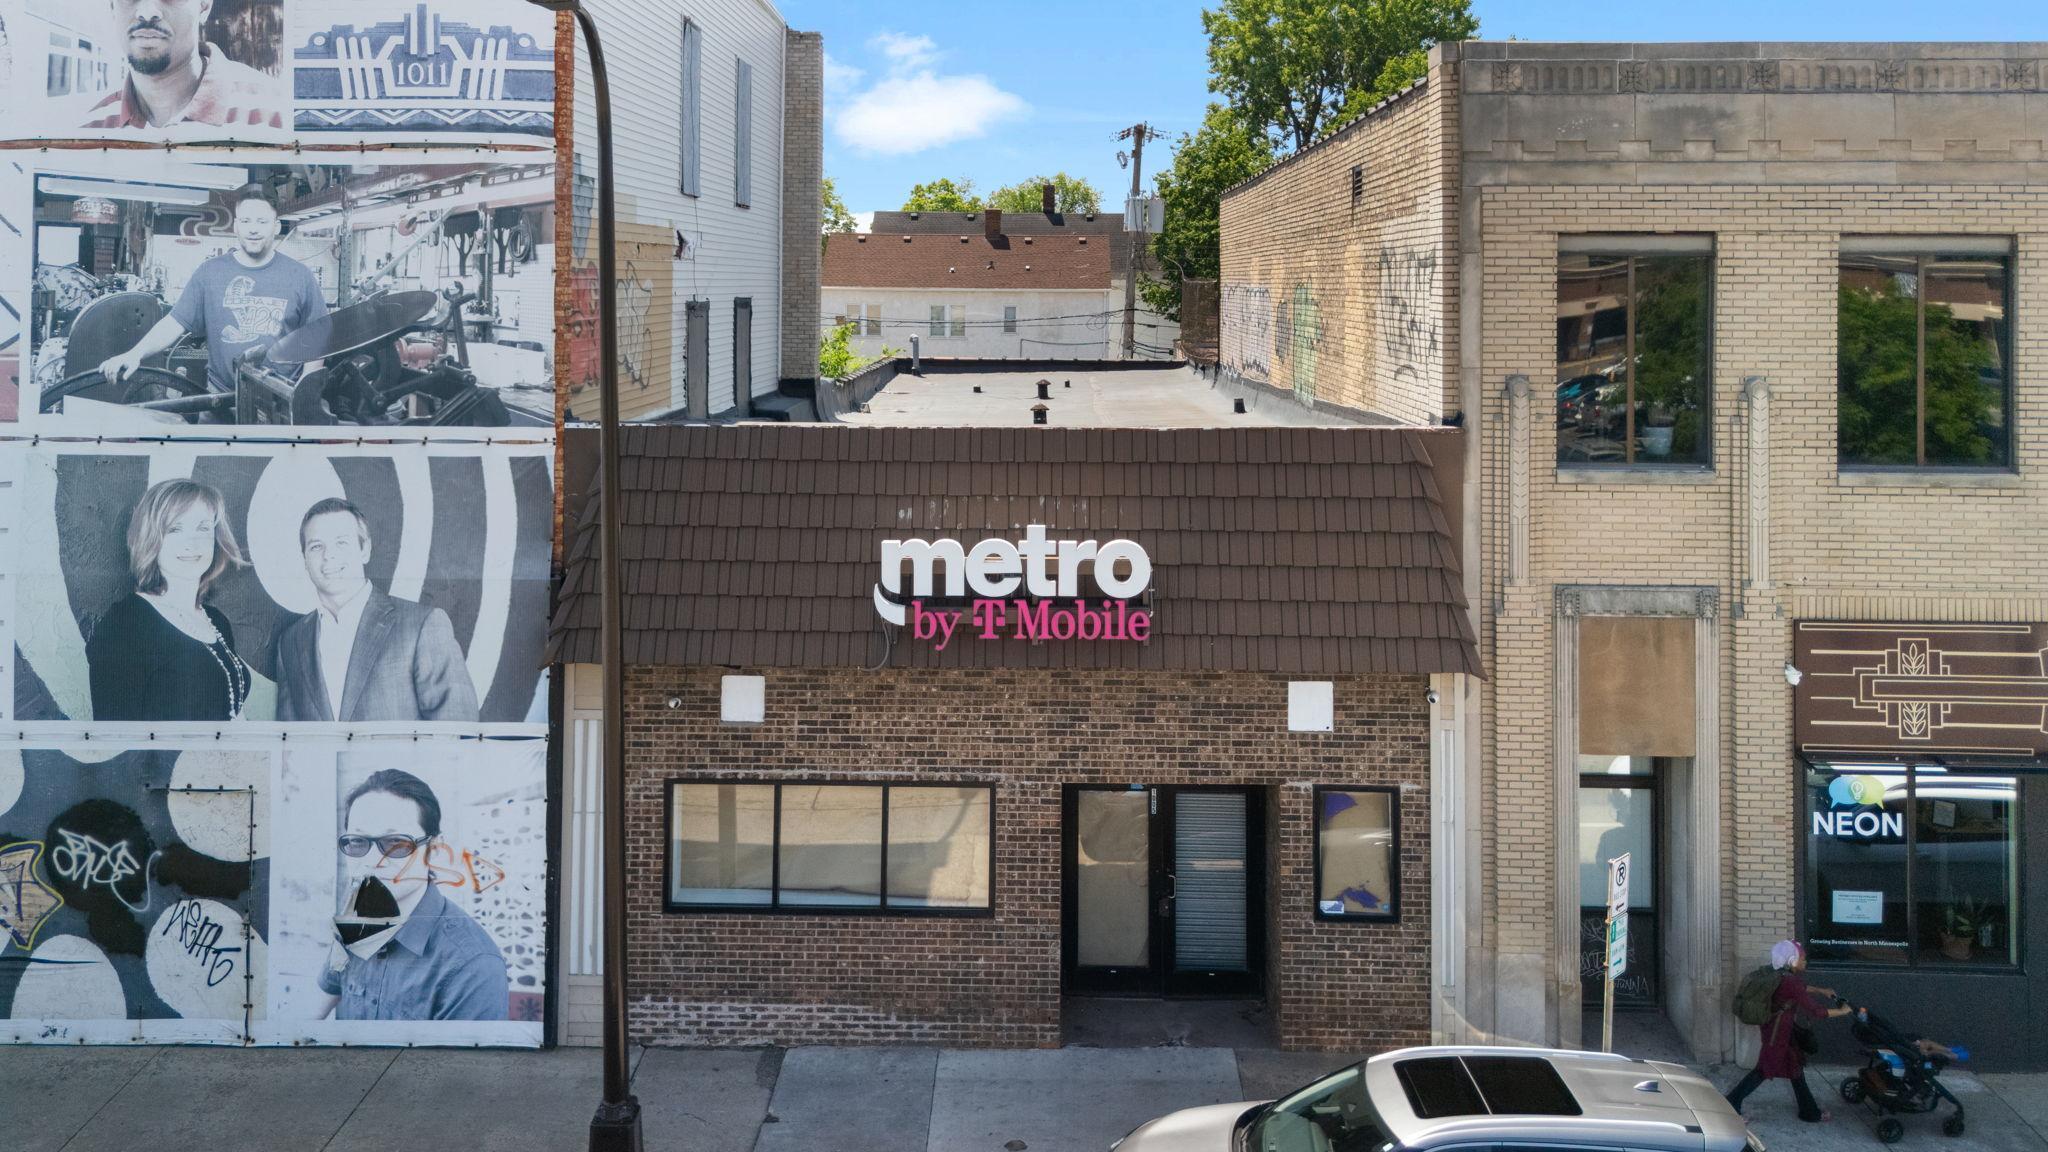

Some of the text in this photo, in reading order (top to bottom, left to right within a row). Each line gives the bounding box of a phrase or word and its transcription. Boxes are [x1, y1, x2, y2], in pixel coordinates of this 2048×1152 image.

[396, 62, 448, 86] 1011
[880, 525, 1151, 599] metro
[912, 600, 961, 650] by
[1014, 600, 1151, 641] Mobile
[1813, 811, 1903, 836] NEON
